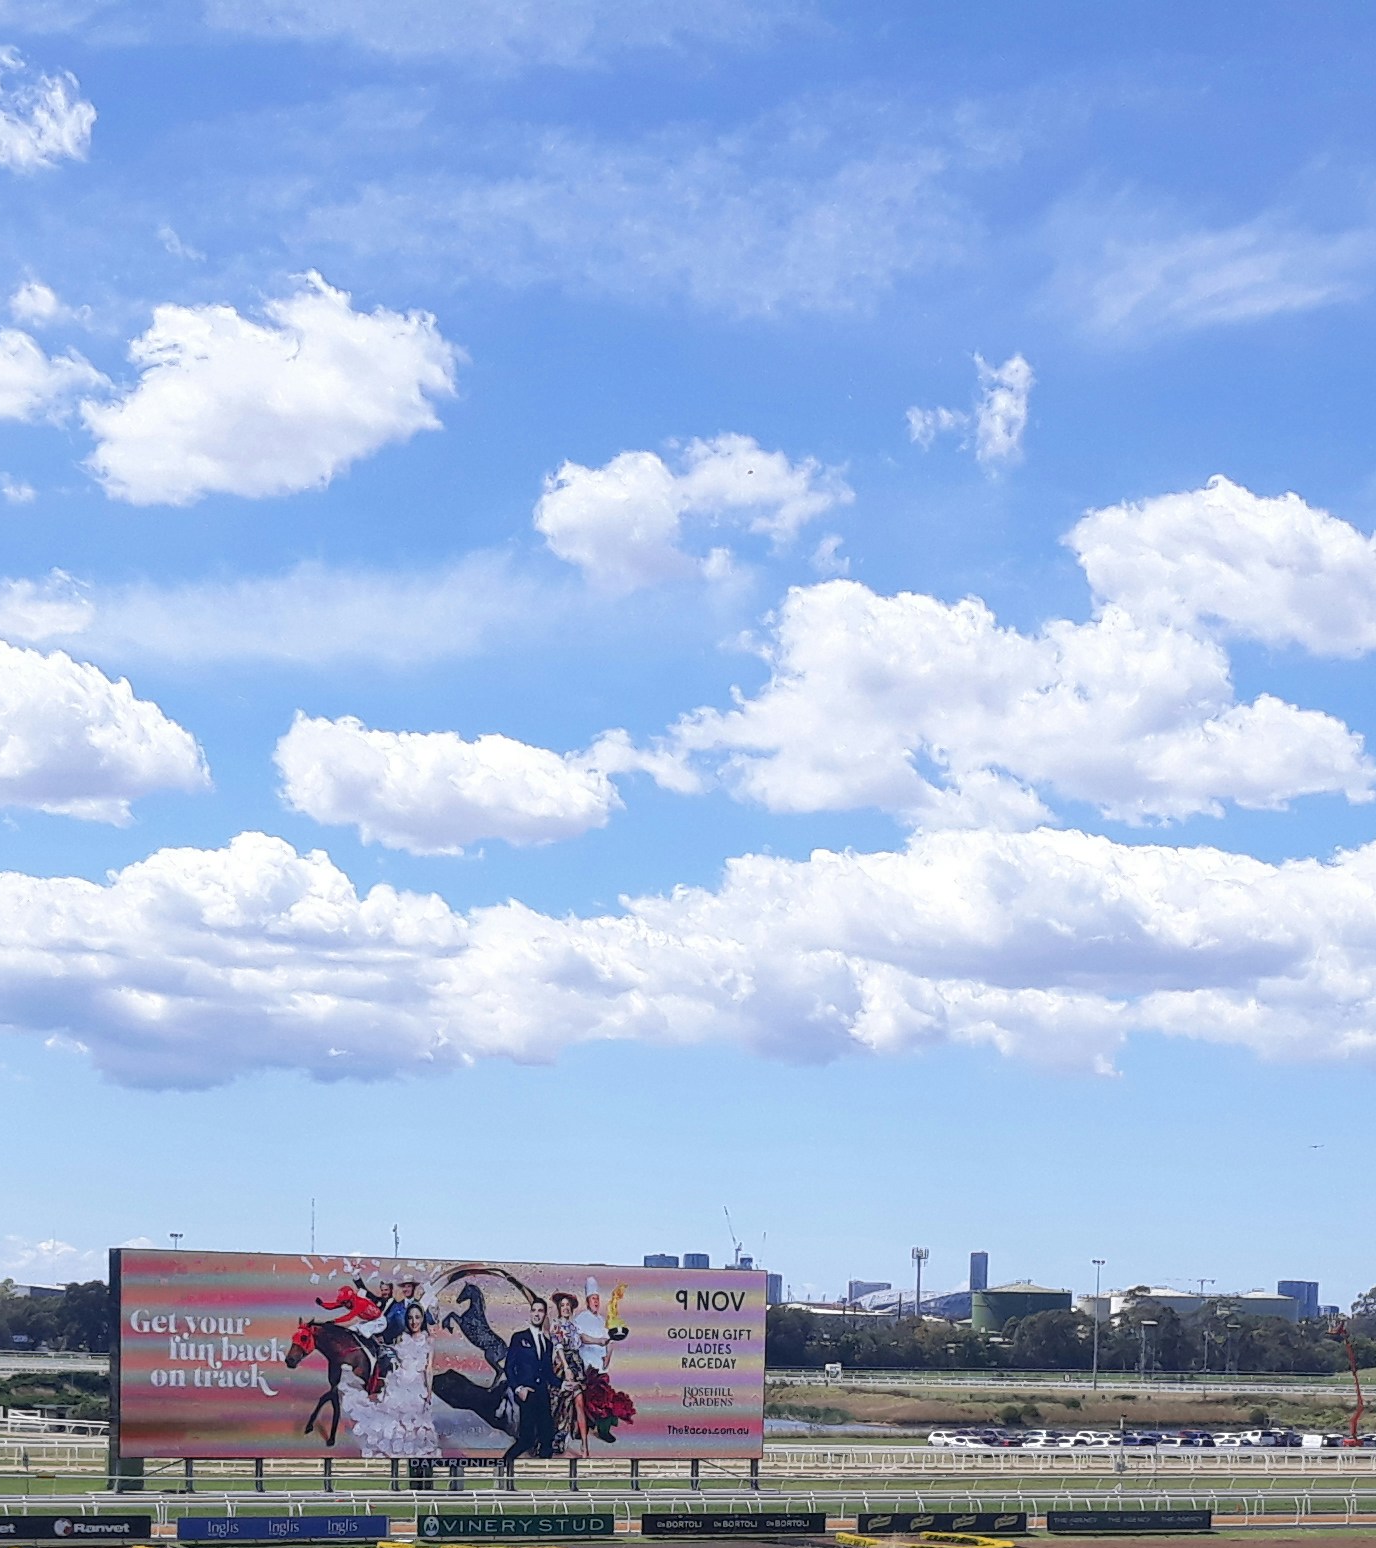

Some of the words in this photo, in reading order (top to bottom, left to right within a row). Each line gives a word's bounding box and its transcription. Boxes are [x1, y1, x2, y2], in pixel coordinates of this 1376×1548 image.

[675, 1289, 688, 1310] 9
[696, 1290, 746, 1312] NOV
[130, 1309, 178, 1334] Get
[182, 1314, 251, 1339] your
[667, 1328, 719, 1341] GOLDEN
[722, 1329, 752, 1341] GIFT
[169, 1334, 223, 1370] fun
[221, 1336, 287, 1362] back
[687, 1343, 732, 1355] LADIES
[681, 1357, 737, 1370] RACEDAY
[150, 1367, 186, 1387] on
[193, 1363, 279, 1397] track
[683, 1386, 734, 1398] ROSEHILL
[682, 1397, 734, 1408] GARDENS
[410, 1458, 505, 1468] DAKTRONICS
[73, 1522, 130, 1534] Ranvet
[207, 1519, 239, 1538] Inglis
[268, 1519, 300, 1536] Inglis
[327, 1518, 358, 1536] Inglis
[442, 1519, 534, 1533] VINERY
[538, 1518, 605, 1532] STUD
